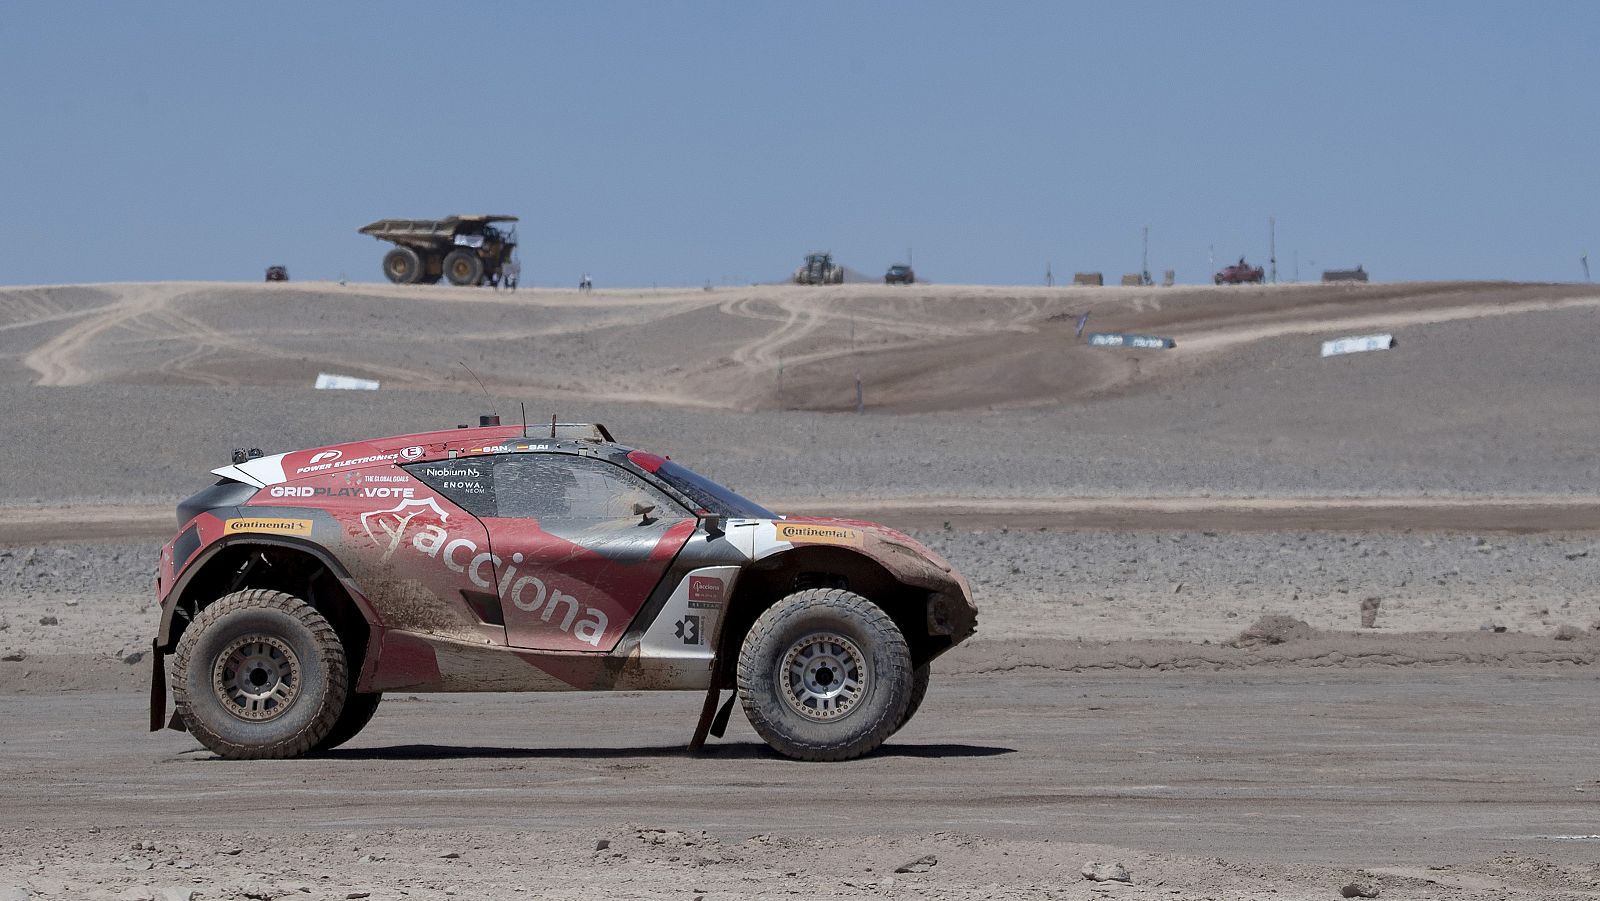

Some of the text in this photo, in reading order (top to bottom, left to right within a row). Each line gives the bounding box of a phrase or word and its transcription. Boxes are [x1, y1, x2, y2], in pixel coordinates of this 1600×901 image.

[296, 453, 400, 474] POWER ELECTRONICS
[426, 467, 467, 477] Niobium
[392, 475, 409, 483] GOALS
[231, 521, 295, 530] Continental
[782, 526, 847, 539] Continental
[412, 523, 609, 647] acciona
